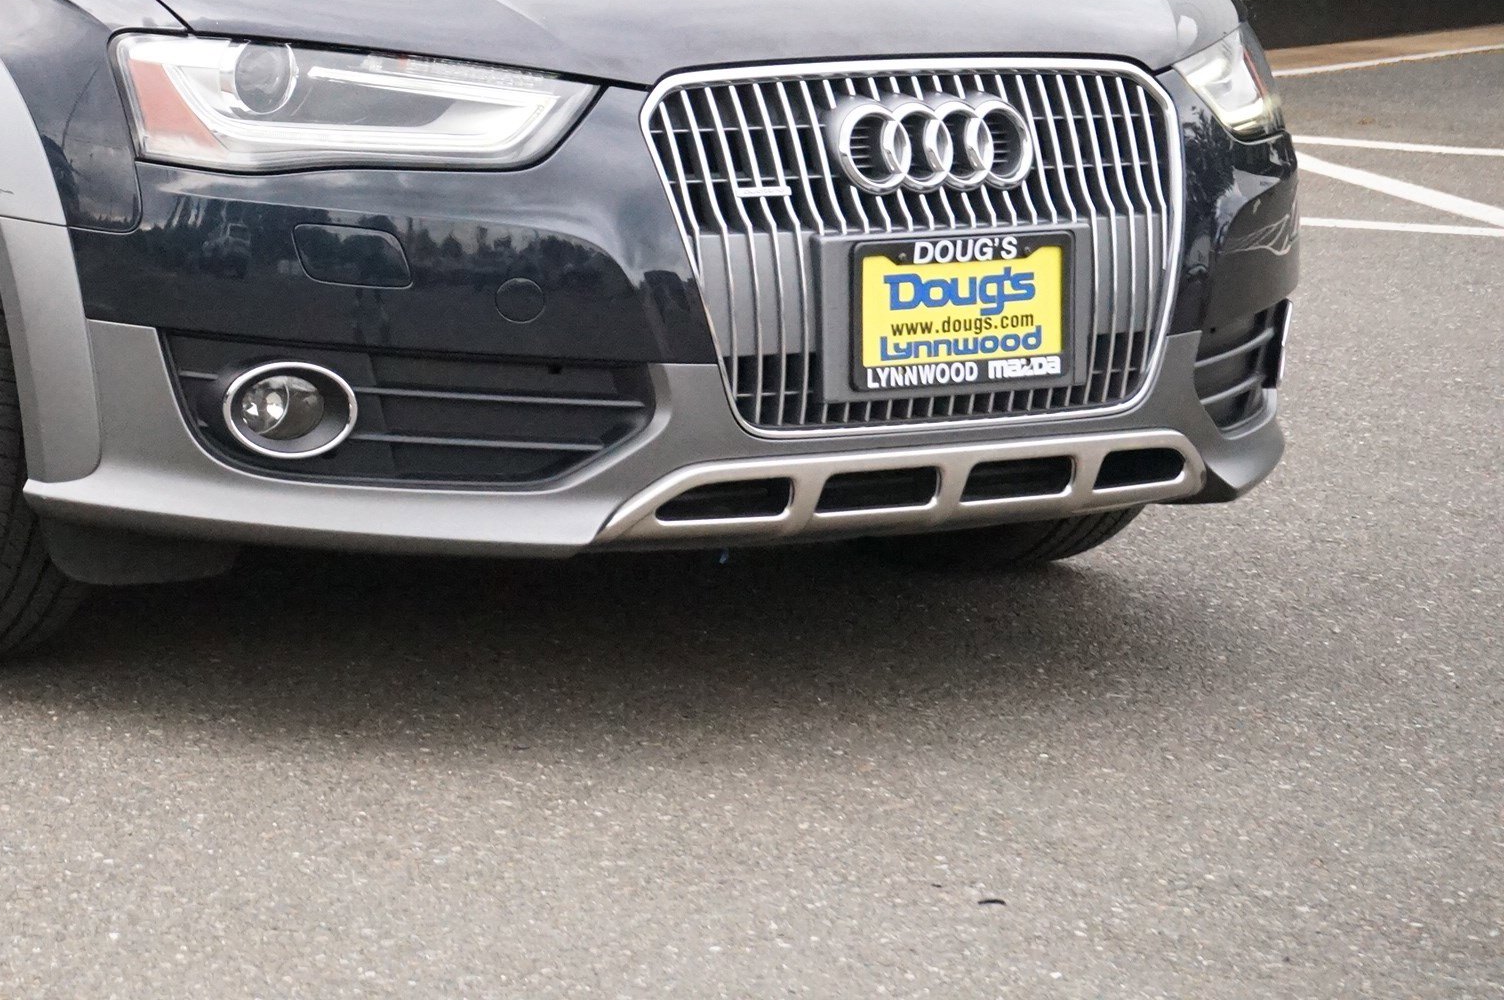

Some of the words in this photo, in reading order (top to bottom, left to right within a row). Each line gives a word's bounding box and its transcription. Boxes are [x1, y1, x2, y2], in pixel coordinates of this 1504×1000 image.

[912, 237, 1018, 264] DOUG'S
[890, 312, 1035, 336] www.dougs.com
[880, 325, 1042, 361] Lynnwood
[866, 361, 979, 389] LYNNWOOD
